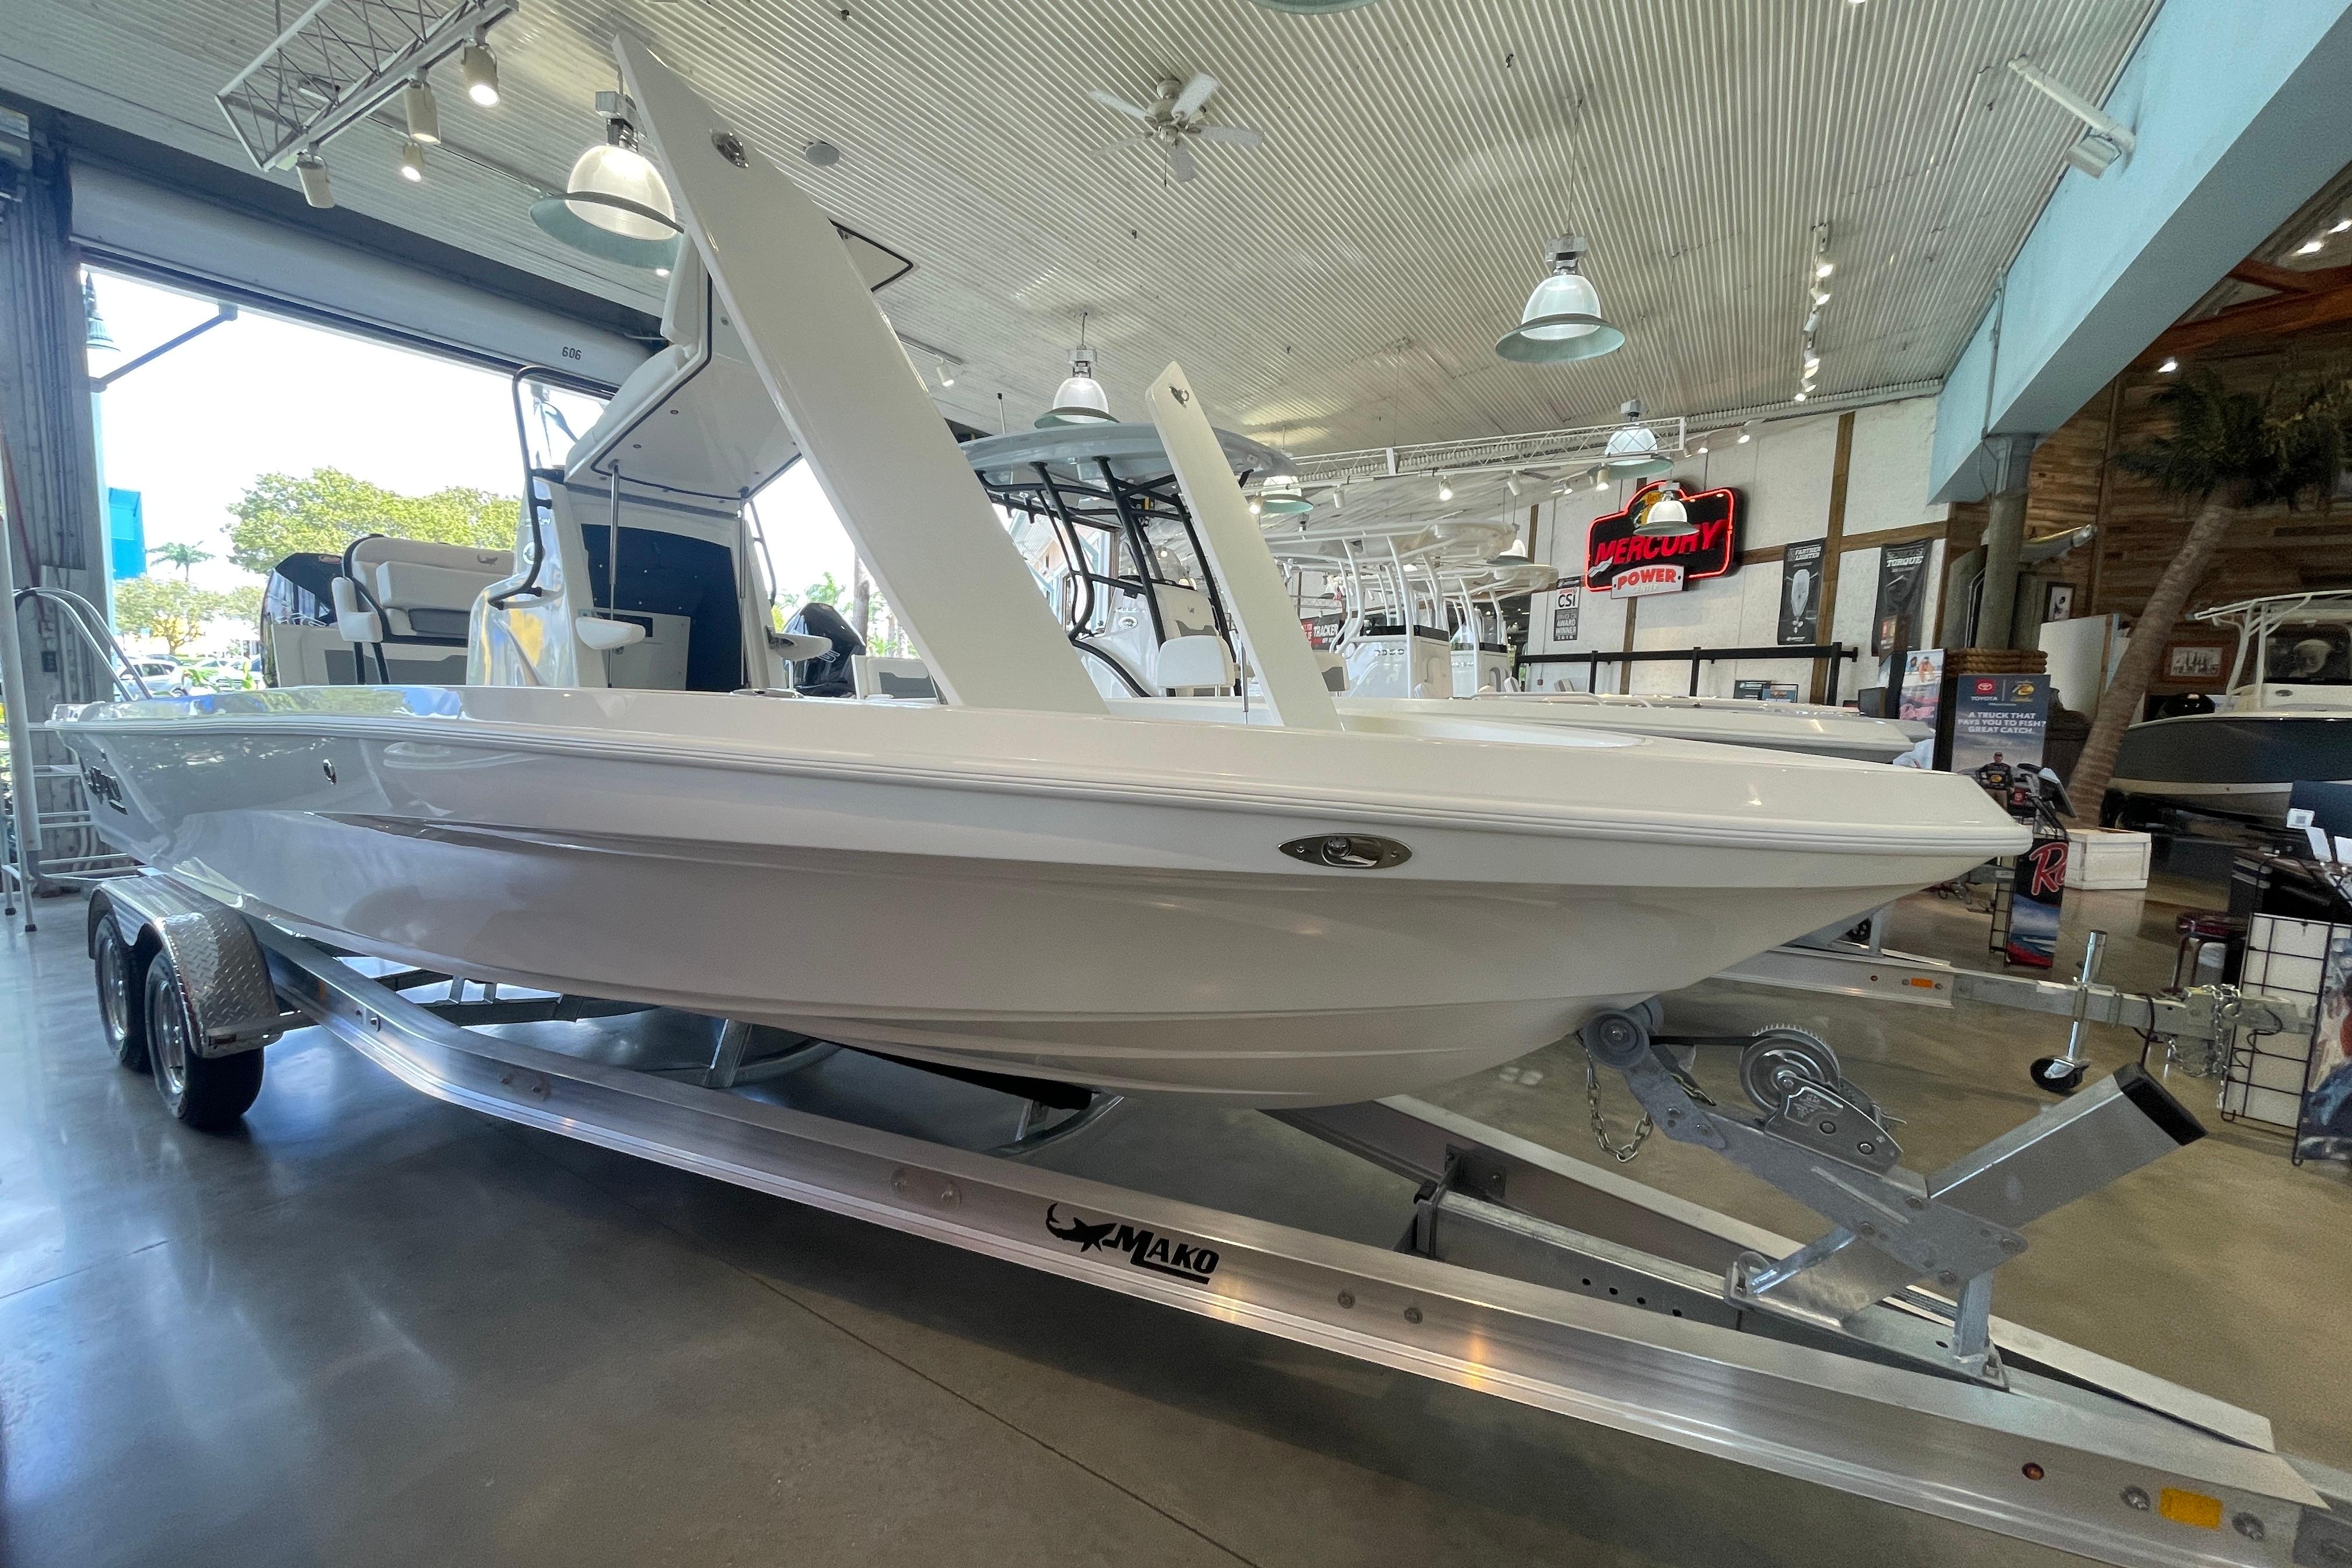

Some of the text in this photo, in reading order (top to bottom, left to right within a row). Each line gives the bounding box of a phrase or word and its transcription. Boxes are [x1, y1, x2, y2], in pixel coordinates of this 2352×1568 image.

[562, 346, 582, 360] 606
[1594, 520, 1728, 565] MERCURY
[1887, 556, 1924, 567] TORQUE
[1618, 568, 1676, 590] POWER
[1633, 584, 1658, 594] CENTER
[1558, 594, 1576, 607] CSI
[1314, 624, 1339, 638] TRACKER
[1555, 626, 1576, 636] WINNER
[1101, 1224, 1220, 1285] MAKO
